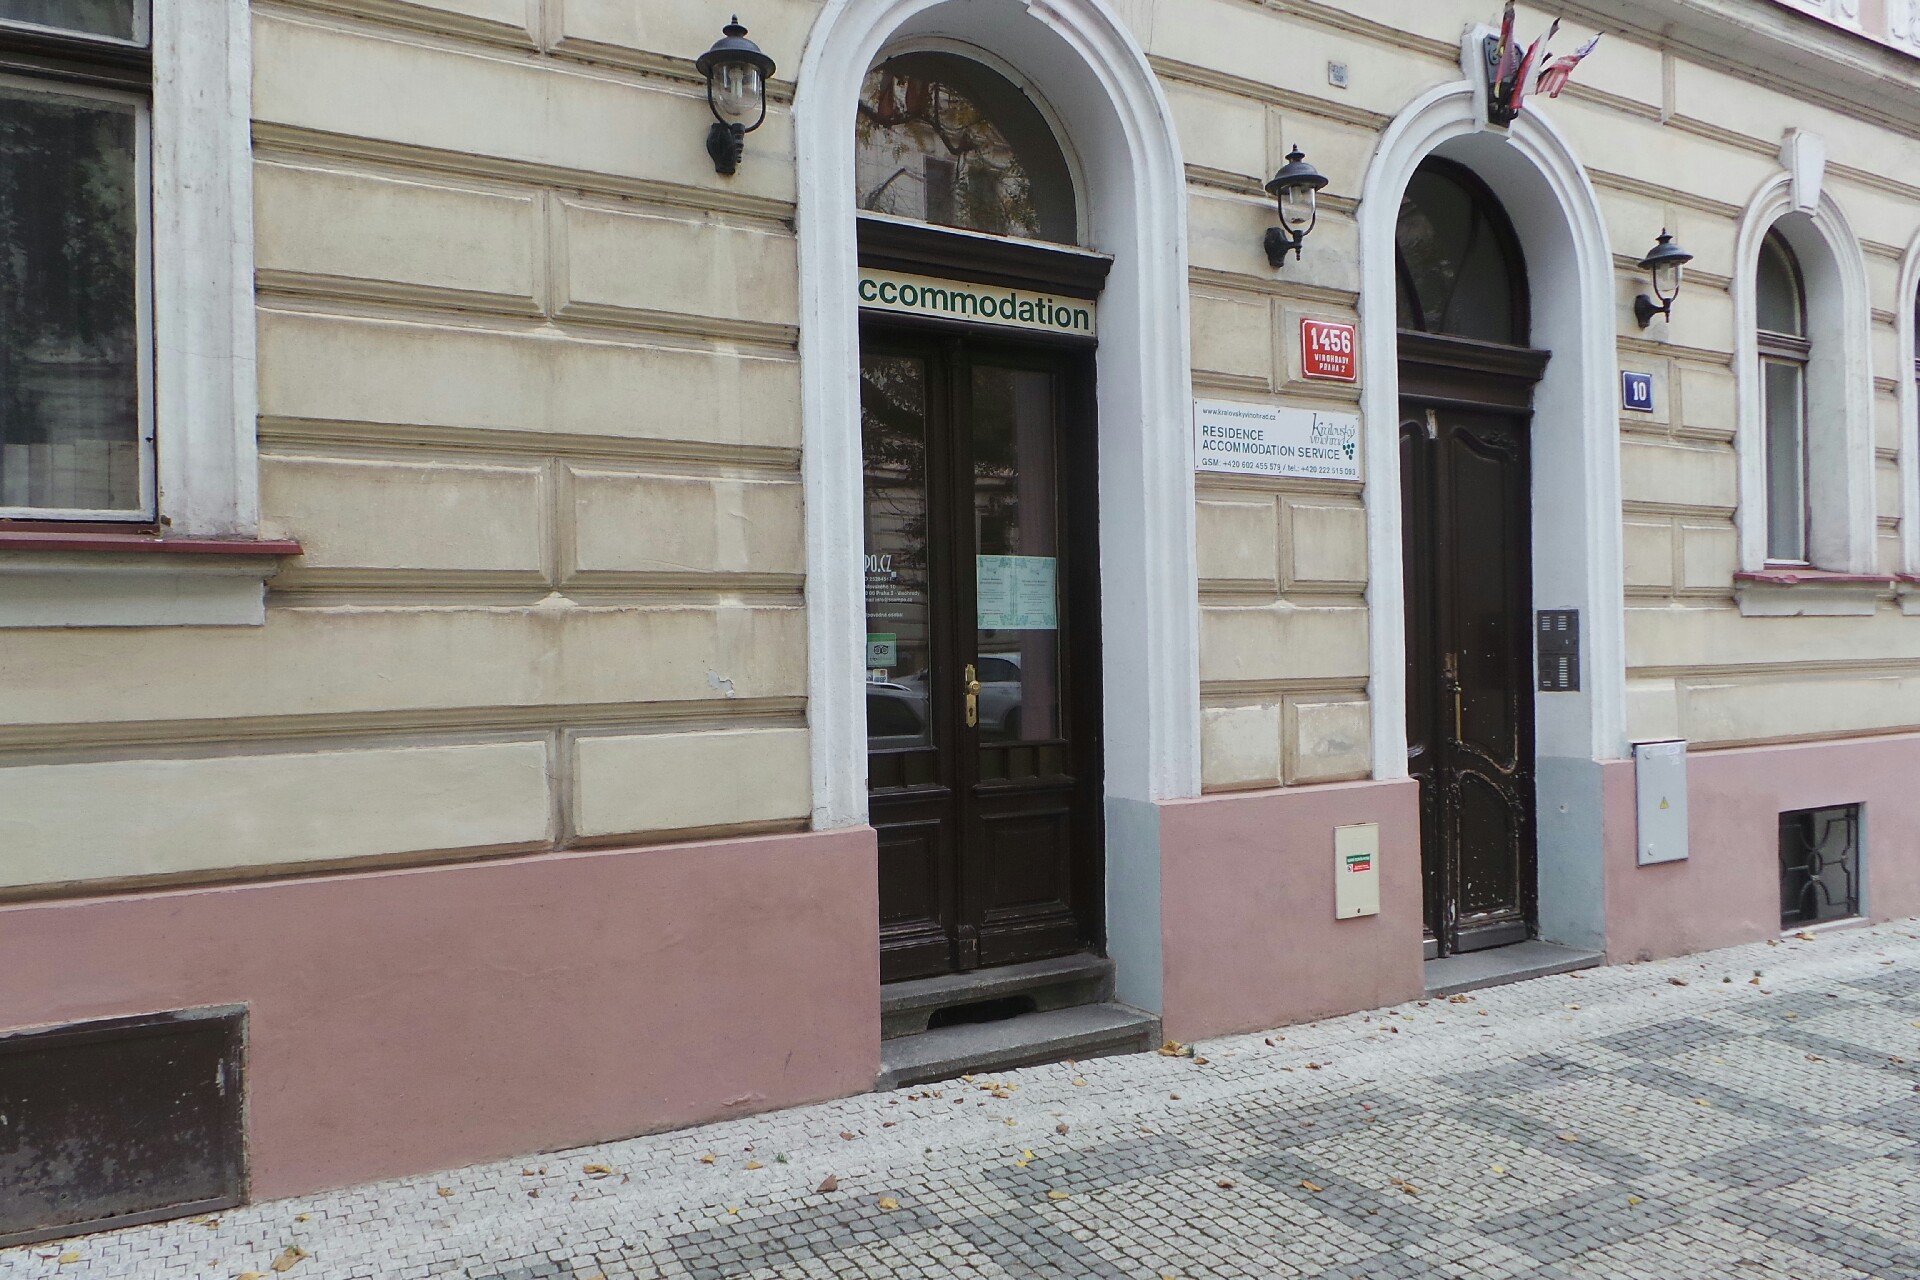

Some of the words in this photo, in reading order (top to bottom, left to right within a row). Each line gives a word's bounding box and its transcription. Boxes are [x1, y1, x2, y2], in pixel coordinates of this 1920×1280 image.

[858, 279, 1089, 330] ccommodation
[1311, 327, 1351, 354] 1456
[1314, 353, 1349, 364] VINOHRADY
[1319, 363, 1339, 372] PRAHA
[1633, 381, 1647, 401] 10
[1202, 425, 1264, 441] RESIDENCE
[1202, 439, 1295, 457] ACCOMMODATION
[1298, 446, 1340, 460] SERVICE
[1223, 460, 1240, 468] +420
[1241, 461, 1254, 469] 602
[1255, 462, 1268, 470] 455
[1301, 465, 1317, 473] +420
[1318, 466, 1331, 474] 222
[864, 554, 892, 573] PO.CZ
